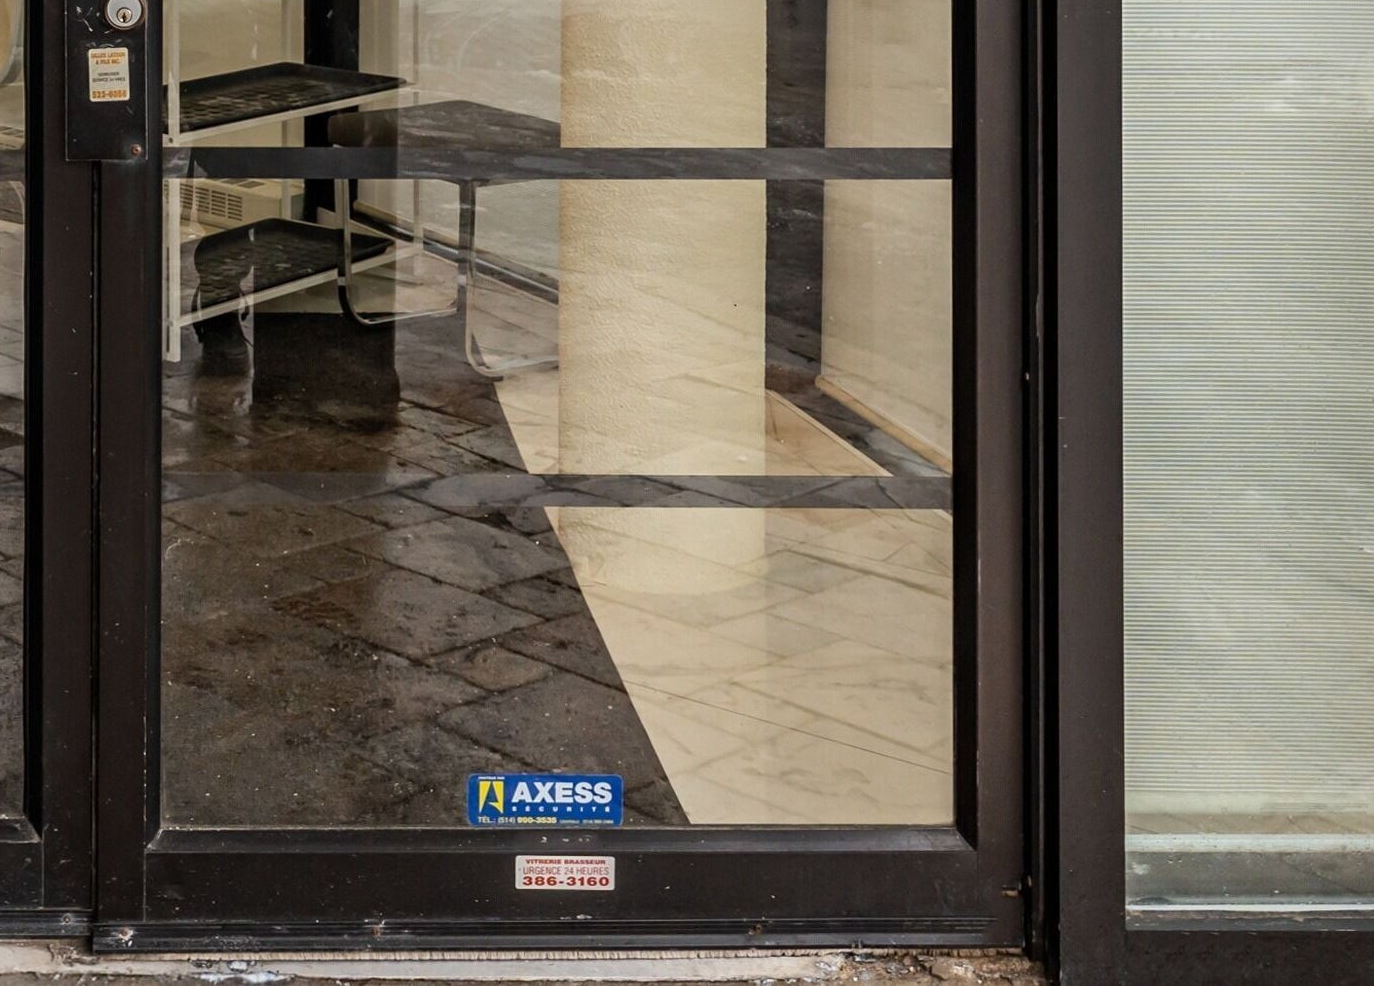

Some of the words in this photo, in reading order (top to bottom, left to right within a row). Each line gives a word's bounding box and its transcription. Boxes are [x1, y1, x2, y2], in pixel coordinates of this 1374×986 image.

[511, 781, 613, 804] AXESS
[511, 805, 611, 813] SÉCURITÉ
[497, 816, 515, 824] (514)
[523, 866, 563, 875] URGENCE
[564, 867, 574, 875] 24
[576, 867, 610, 875] HEURES
[522, 876, 610, 887] 386-3160
